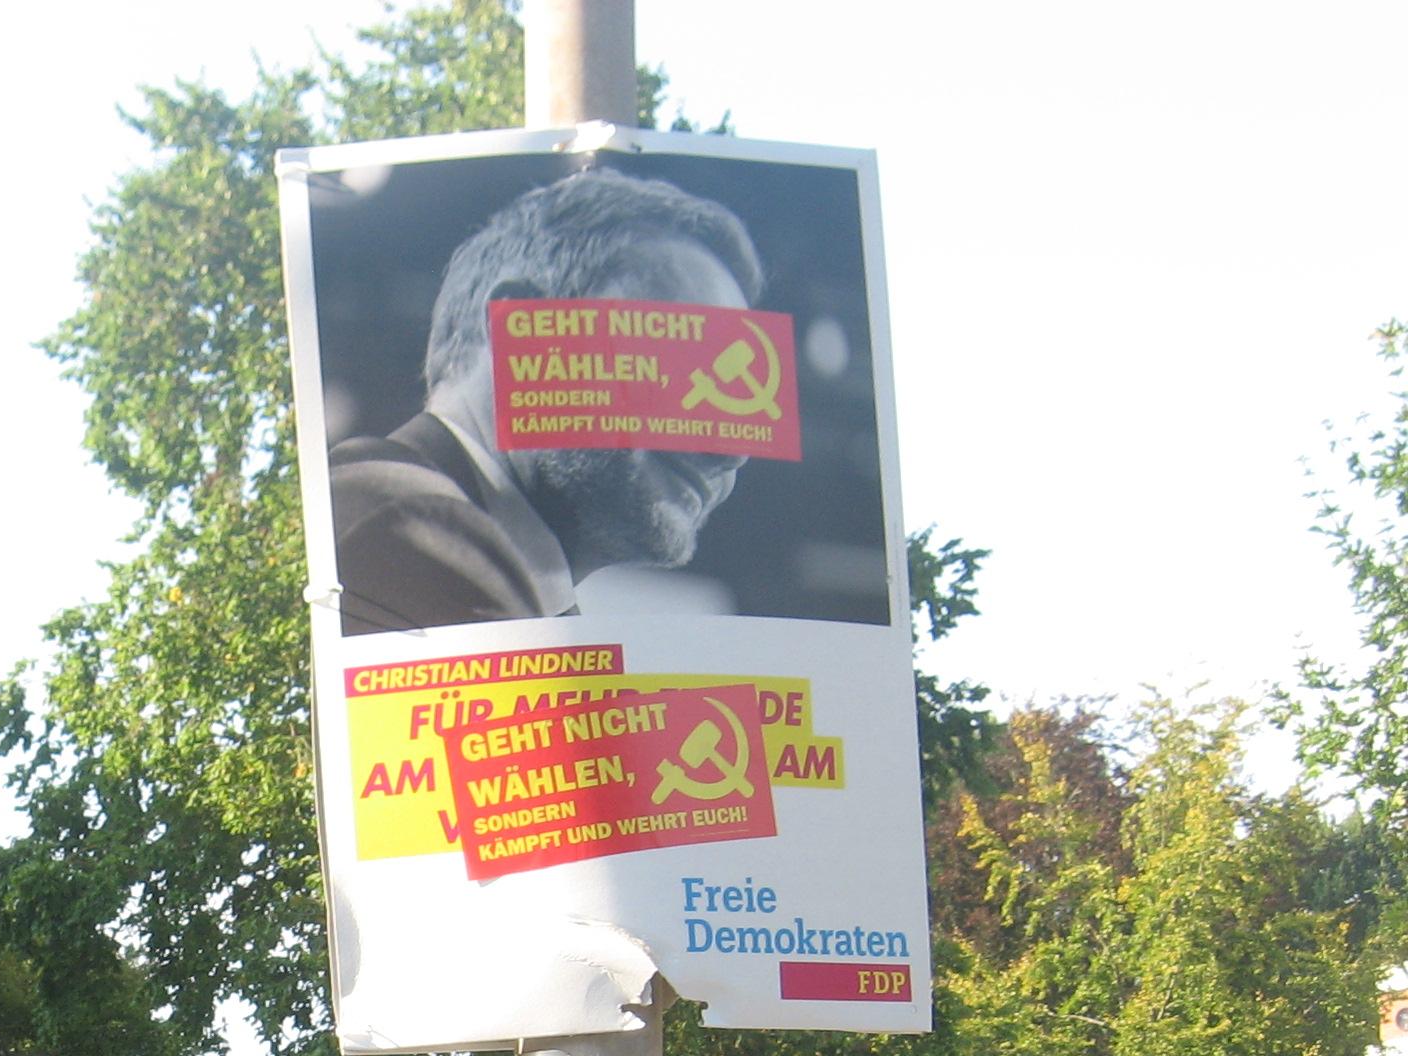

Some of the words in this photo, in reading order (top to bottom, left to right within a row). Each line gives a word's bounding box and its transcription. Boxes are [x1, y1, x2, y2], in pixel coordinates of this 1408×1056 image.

[506, 309, 599, 338] GEHT
[608, 310, 707, 341] NICHT
[508, 347, 670, 389] WÄHLEN,
[510, 390, 611, 408] SONDERN
[511, 413, 594, 434] KÄMPFT
[600, 416, 642, 433] UND
[647, 417, 714, 437] WEHRT
[719, 422, 773, 442] EUCH!
[353, 658, 491, 693] CHRISTIAN
[499, 650, 615, 678] LINDNER
[460, 718, 554, 762] GEHT
[562, 703, 667, 744] NICHT
[359, 757, 436, 799] AM
[773, 743, 837, 780] AM
[467, 755, 637, 809] WÄHLEN,
[473, 801, 577, 835] SONDERN
[478, 830, 562, 862] KÄMPFT
[567, 822, 612, 845] UND
[617, 813, 688, 836] WEHRT
[691, 806, 748, 827] EUCH!
[681, 877, 777, 913] Freie
[684, 917, 910, 957] Demokraten
[857, 970, 907, 994] FDP
